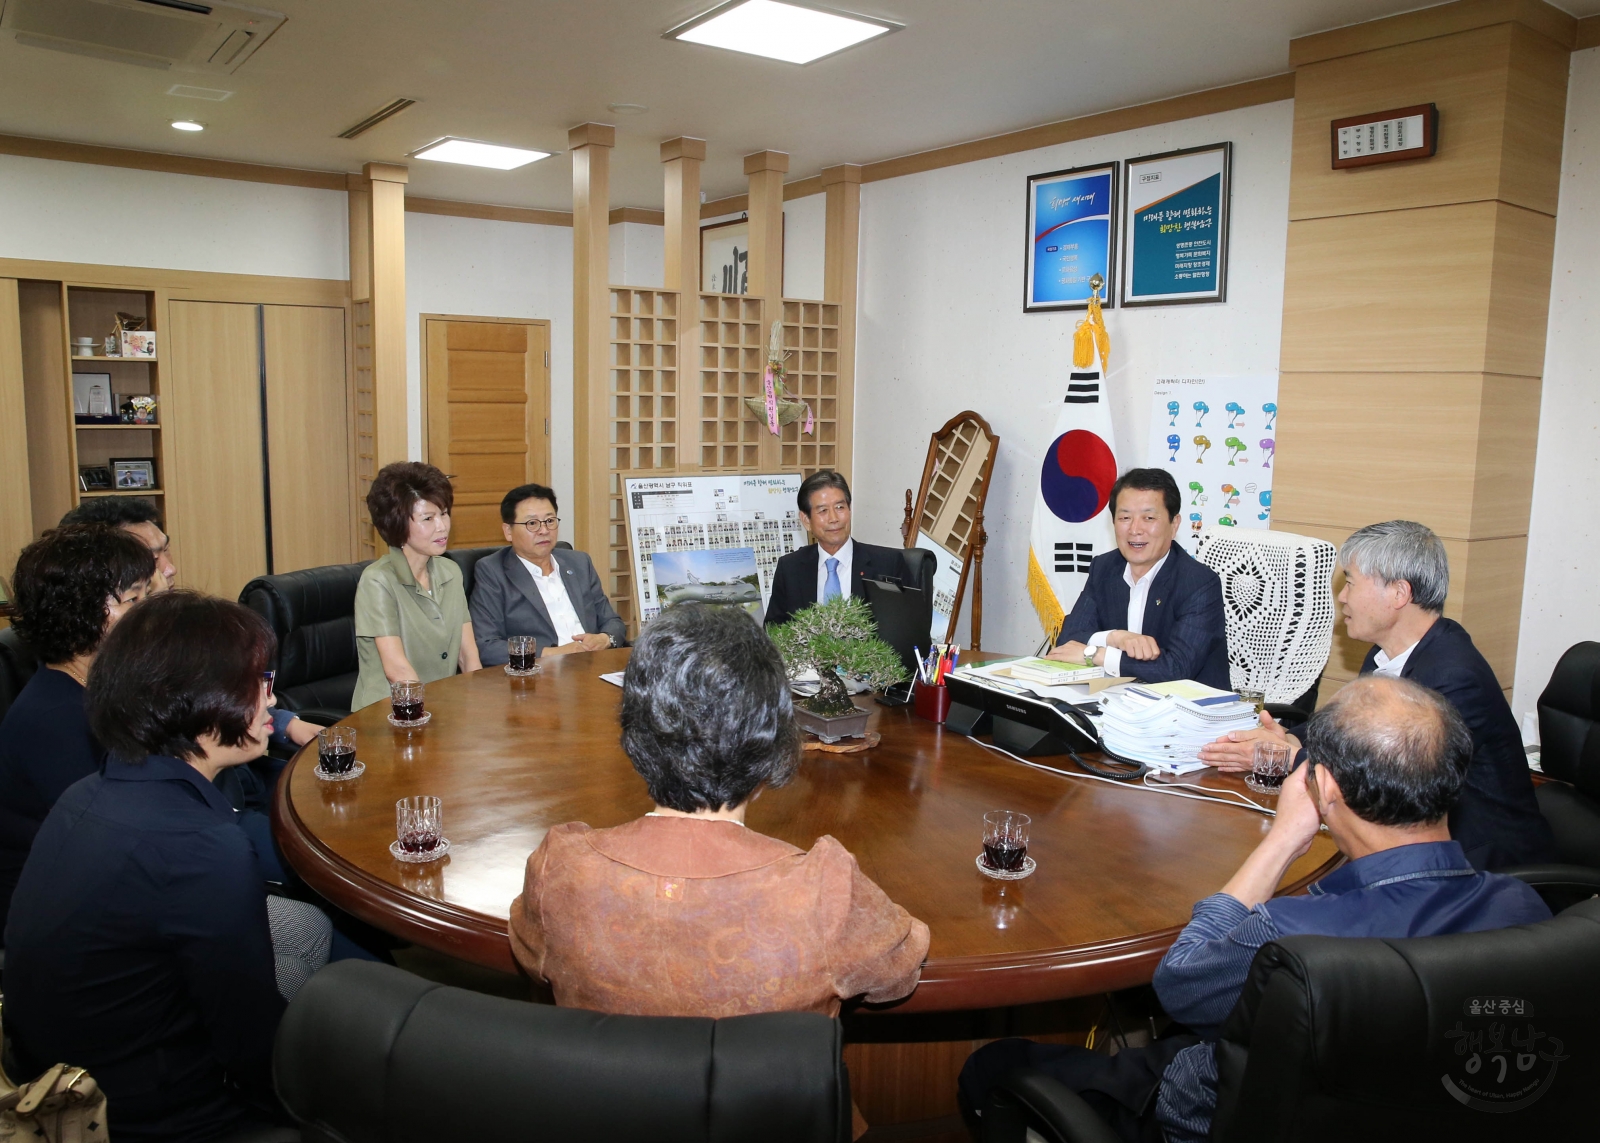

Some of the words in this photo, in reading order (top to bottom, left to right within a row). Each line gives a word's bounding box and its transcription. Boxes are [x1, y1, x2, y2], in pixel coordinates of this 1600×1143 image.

[1143, 210, 1164, 222] 미래를
[1166, 209, 1181, 221] 향해
[1183, 205, 1212, 218] 변화하는
[1160, 222, 1182, 234] 희망찬
[1184, 218, 1212, 231] 행복남구
[1006, 704, 1027, 714] SAMSUNG
